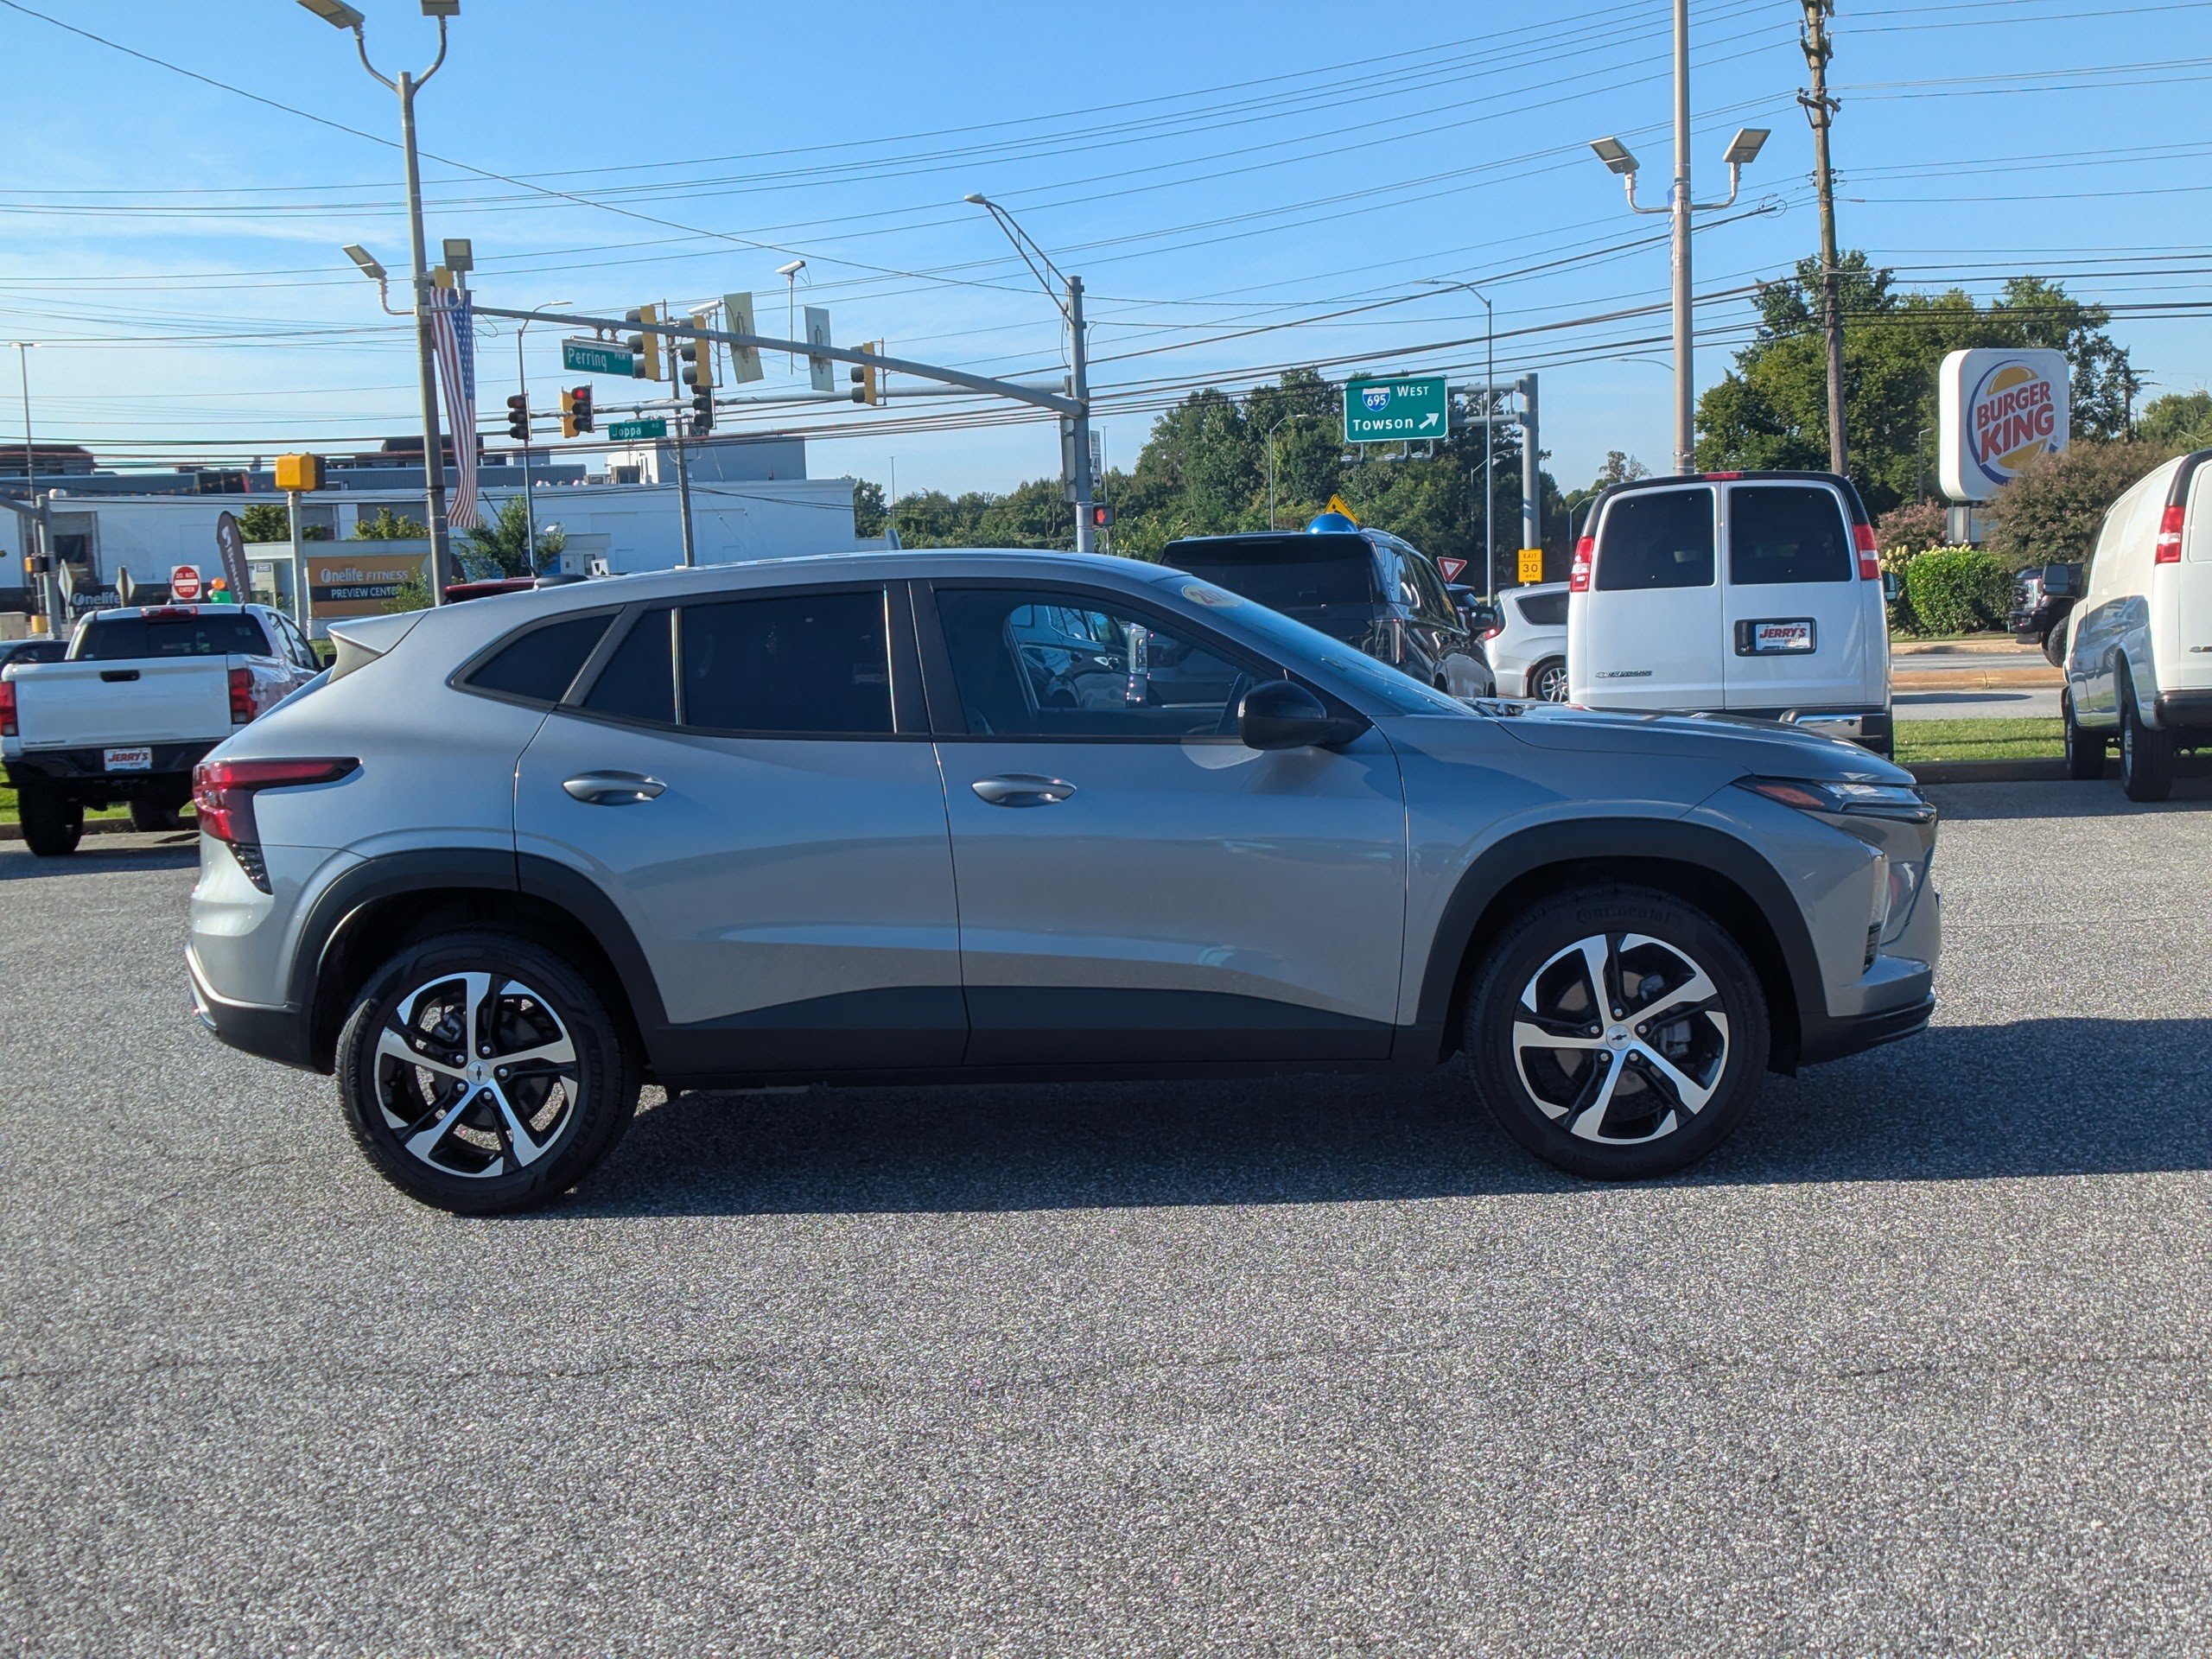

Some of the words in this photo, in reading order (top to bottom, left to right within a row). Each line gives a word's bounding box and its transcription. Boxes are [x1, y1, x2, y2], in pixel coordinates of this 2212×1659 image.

[568, 346, 607, 372] Perring
[1367, 394, 1387, 407] 695
[1396, 385, 1429, 397] WEST
[1977, 381, 2051, 431] BURGER
[612, 426, 642, 437] Joppa
[1352, 418, 1414, 431] Towson
[1980, 403, 2055, 463] KING
[1522, 563, 1538, 573] 30
[321, 568, 364, 583] Onelife
[366, 570, 409, 582] FITNESS
[72, 591, 122, 606] Onelife
[331, 588, 368, 599] PREVIEW
[370, 587, 399, 597] CENTE
[1759, 626, 1808, 639] JERRY'S
[108, 752, 149, 762] JERRY'S
